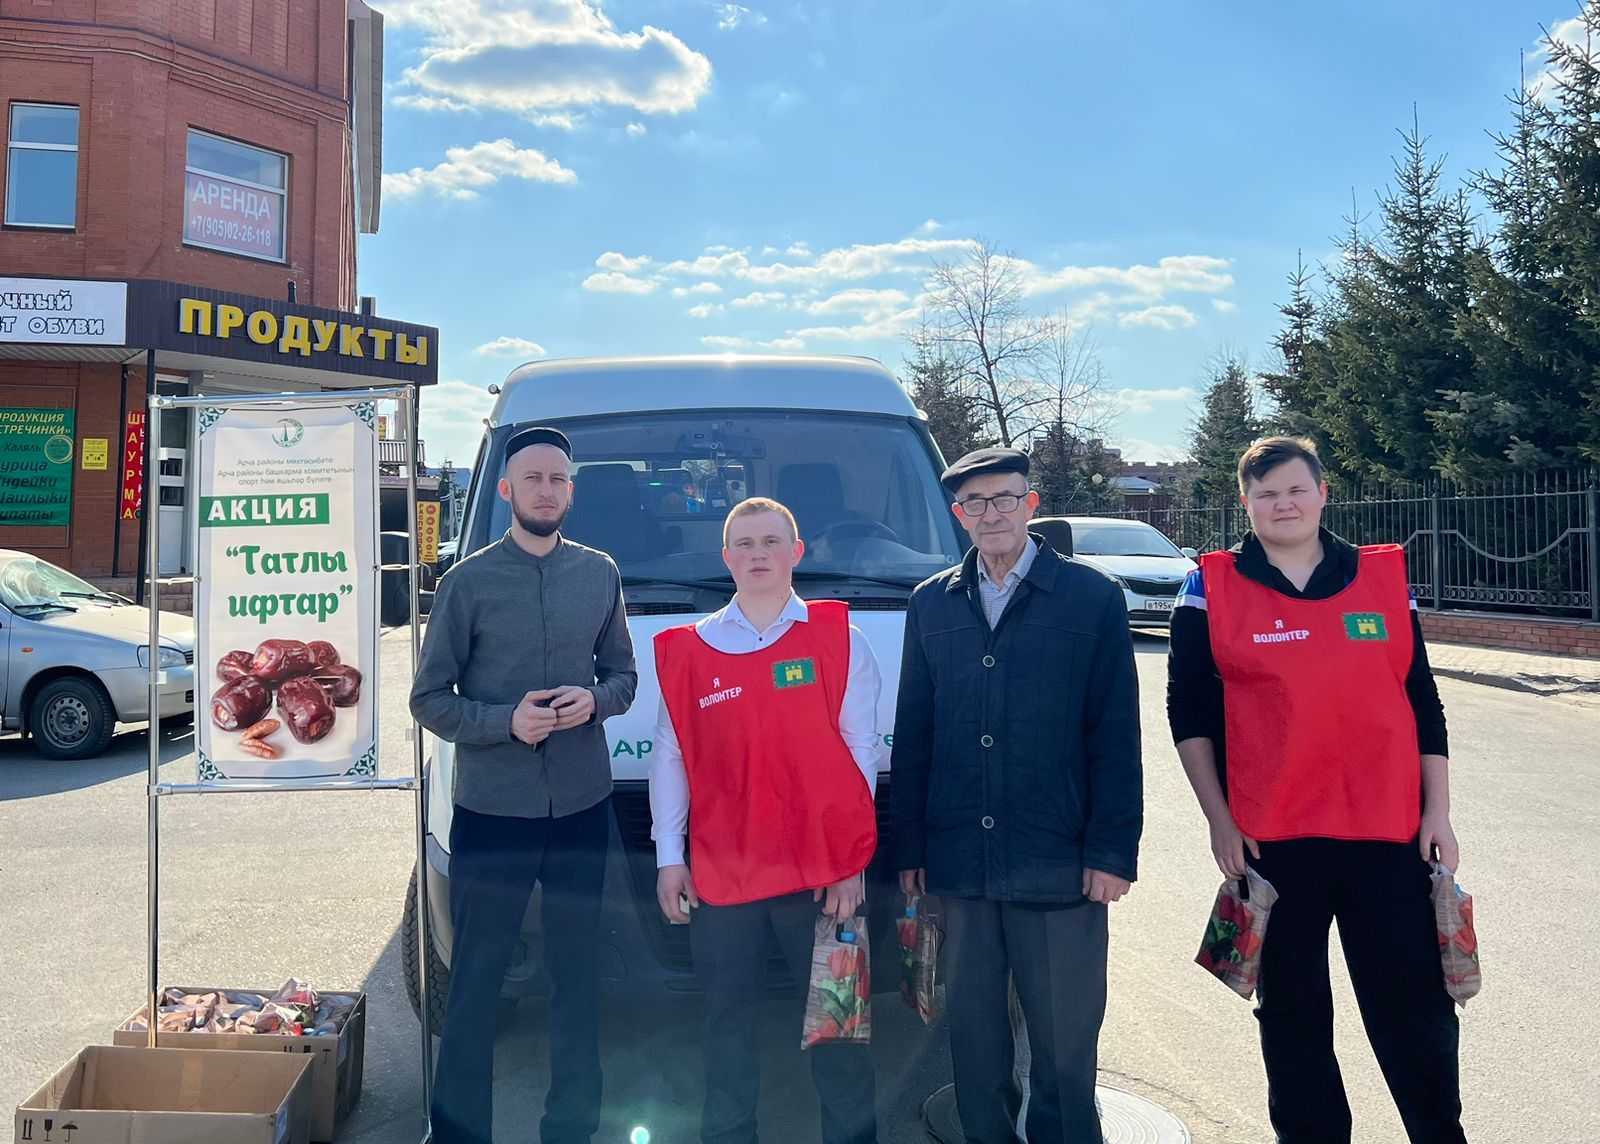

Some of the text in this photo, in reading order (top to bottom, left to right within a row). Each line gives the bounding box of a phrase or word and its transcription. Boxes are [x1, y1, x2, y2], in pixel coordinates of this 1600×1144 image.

[192, 180, 271, 220] АРЕНДА
[191, 215, 271, 247] +7(905)02-26-118
[28, 316, 105, 335] ОБУВИ
[179, 297, 428, 365] ПРОДУКТЫ
[123, 412, 139, 519] ШАУРМА
[217, 469, 235, 477] Арча
[236, 468, 264, 477] районы
[237, 459, 255, 467] Арча
[257, 458, 284, 466] районы
[207, 497, 317, 524] АКЦИЯ
[225, 544, 348, 576] “Татлы
[227, 584, 353, 624] ифтар”
[1253, 630, 1309, 643] ВОЛОНТЕР
[1275, 620, 1284, 629] Я
[712, 677, 720, 688] Я
[699, 686, 743, 709] ВОЛОНТЕР
